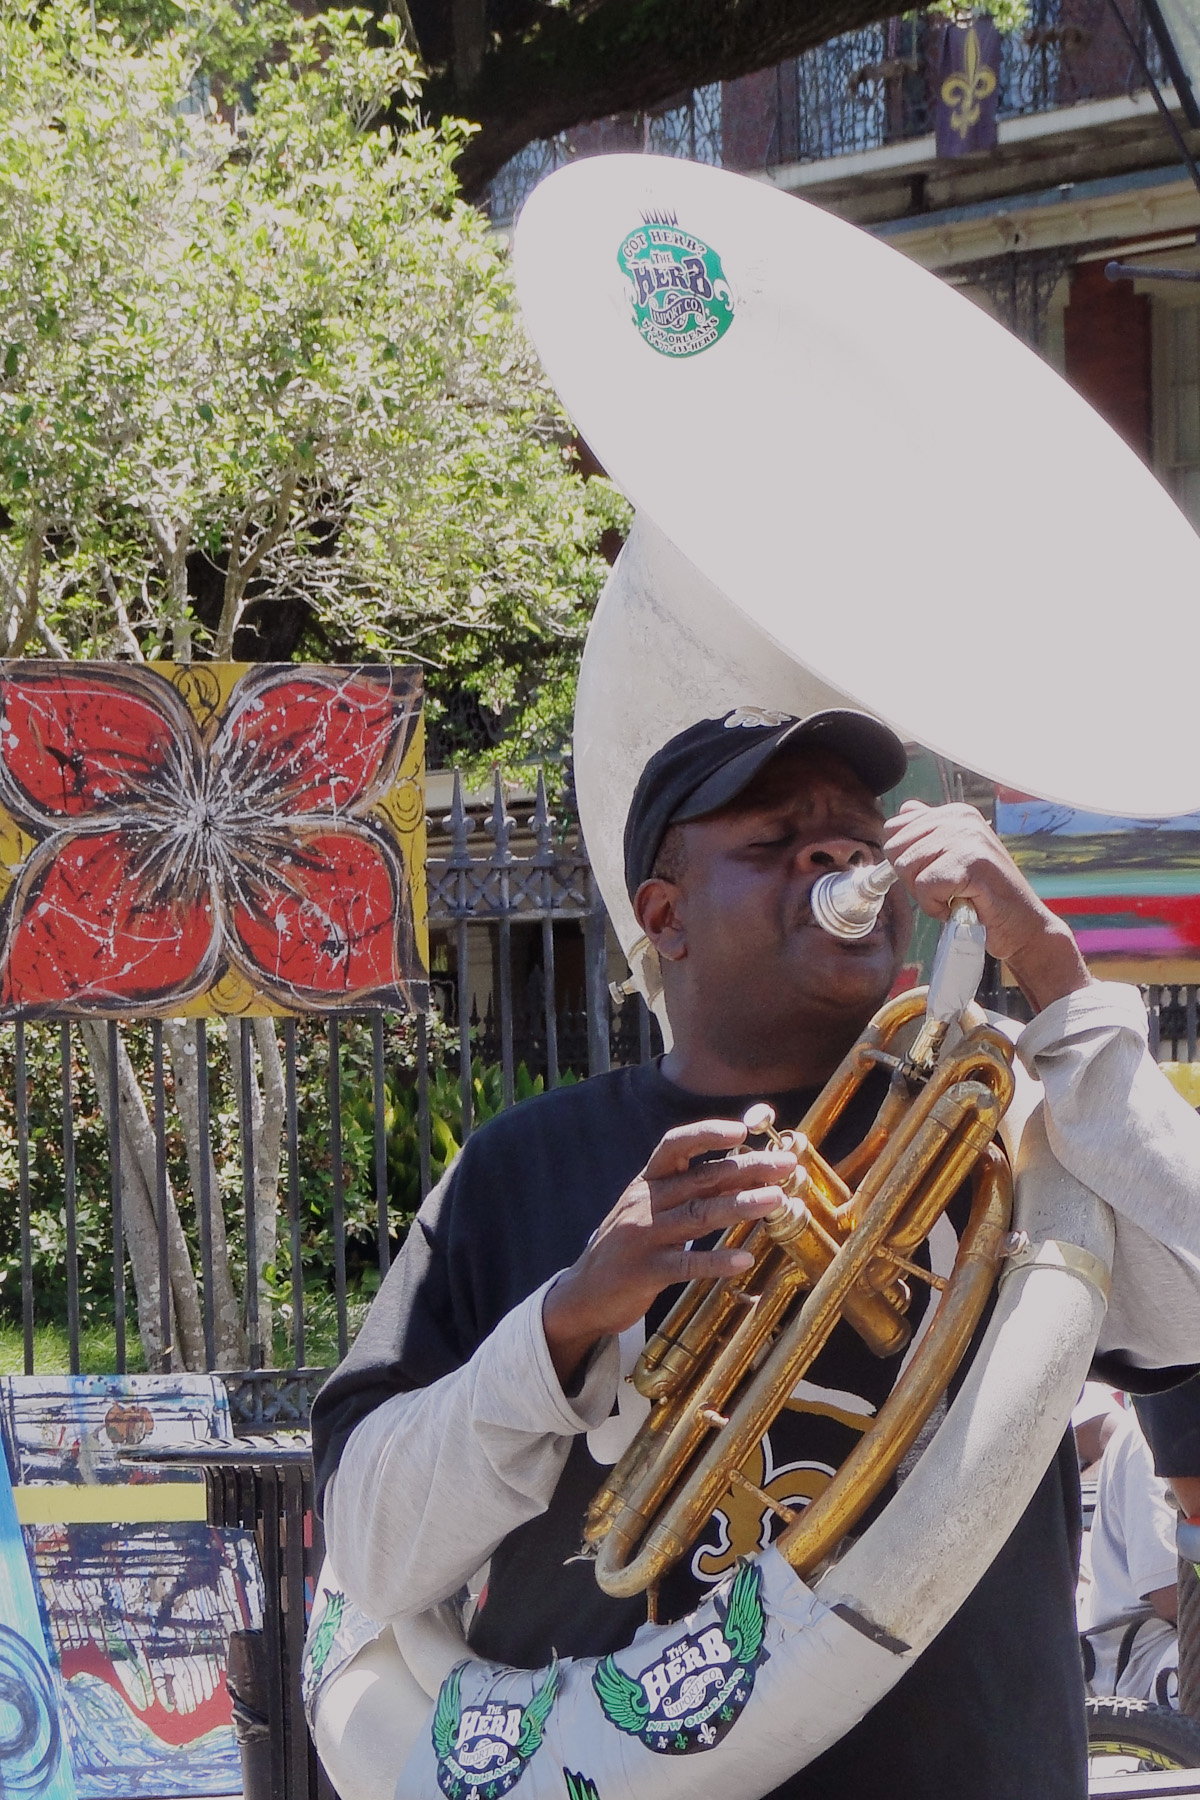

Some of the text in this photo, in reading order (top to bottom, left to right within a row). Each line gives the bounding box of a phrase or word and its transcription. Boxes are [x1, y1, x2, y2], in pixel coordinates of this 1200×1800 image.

[623, 230, 707, 258] GOT HERB?
[652, 252, 673, 264] THE
[631, 257, 713, 306] HERB
[652, 298, 703, 325] IMPORT CO.
[643, 317, 719, 344] NEW ORLEANS
[667, 1641, 689, 1660] THE
[641, 1628, 732, 1713] HERB
[646, 1667, 746, 1732] NEW ORLEANS
[666, 1669, 721, 1716] IMPORT CO.
[486, 1704, 503, 1715] THE
[454, 1709, 522, 1751] HERB
[461, 1747, 490, 1763] IMPORT
[444, 1756, 521, 1784] NEW ORLEANS
